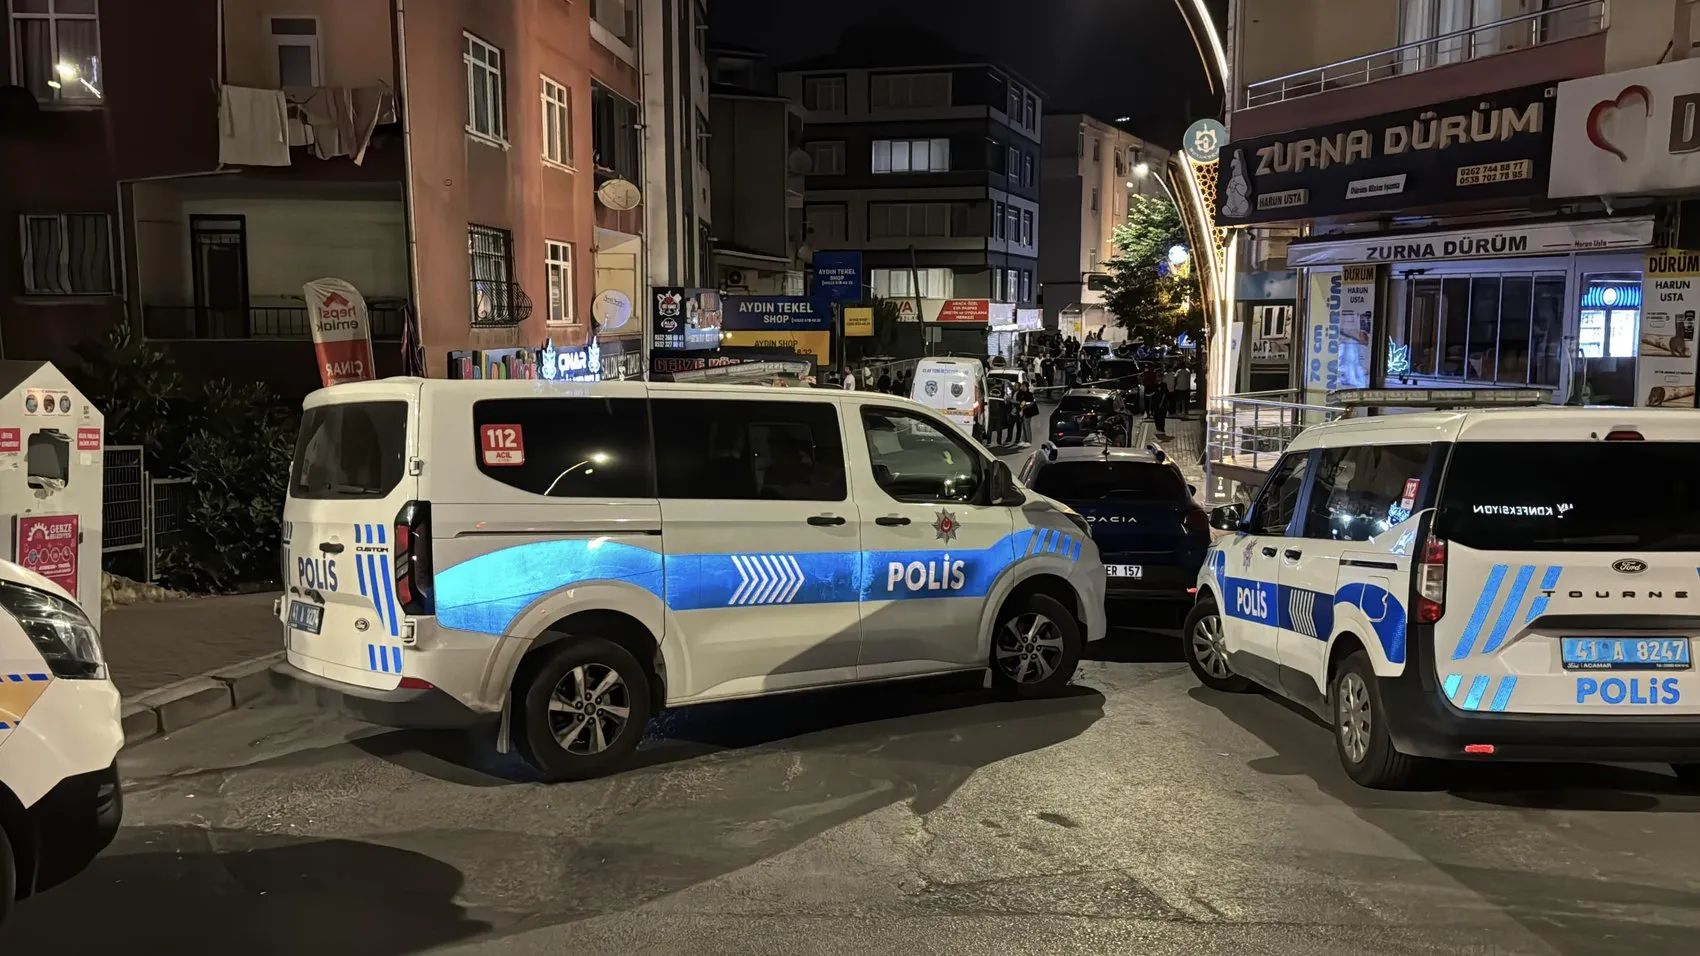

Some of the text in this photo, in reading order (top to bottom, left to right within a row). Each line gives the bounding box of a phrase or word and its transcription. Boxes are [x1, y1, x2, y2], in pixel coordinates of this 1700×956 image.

[1255, 102, 1544, 177] ZURNA DÜRÜM
[1460, 167, 1480, 176] 0262
[1483, 165, 1497, 173] 744
[1513, 161, 1524, 170] 77
[1482, 174, 1497, 182] 702
[1259, 193, 1302, 207] HARUN USTA
[1366, 235, 1527, 260] ZURNA DÜRÜM
[1575, 239, 1607, 248] Harun Usta
[1649, 252, 1700, 273] DÜRÜM
[1655, 281, 1691, 290] HARUN
[1350, 296, 1365, 304] USTA
[1660, 293, 1684, 302] USTA
[739, 302, 813, 313] AYDIN TEKEL
[763, 315, 790, 324] SHOP
[755, 340, 798, 348] AYDIN SHOP
[487, 428, 517, 448] 112
[1405, 482, 1417, 498] 112
[50, 523, 72, 534] GEBZE
[887, 552, 966, 592] POLİS
[1123, 566, 1140, 577] 157
[1237, 581, 1268, 619] POLİS
[1576, 641, 1685, 660] 41 A 8247
